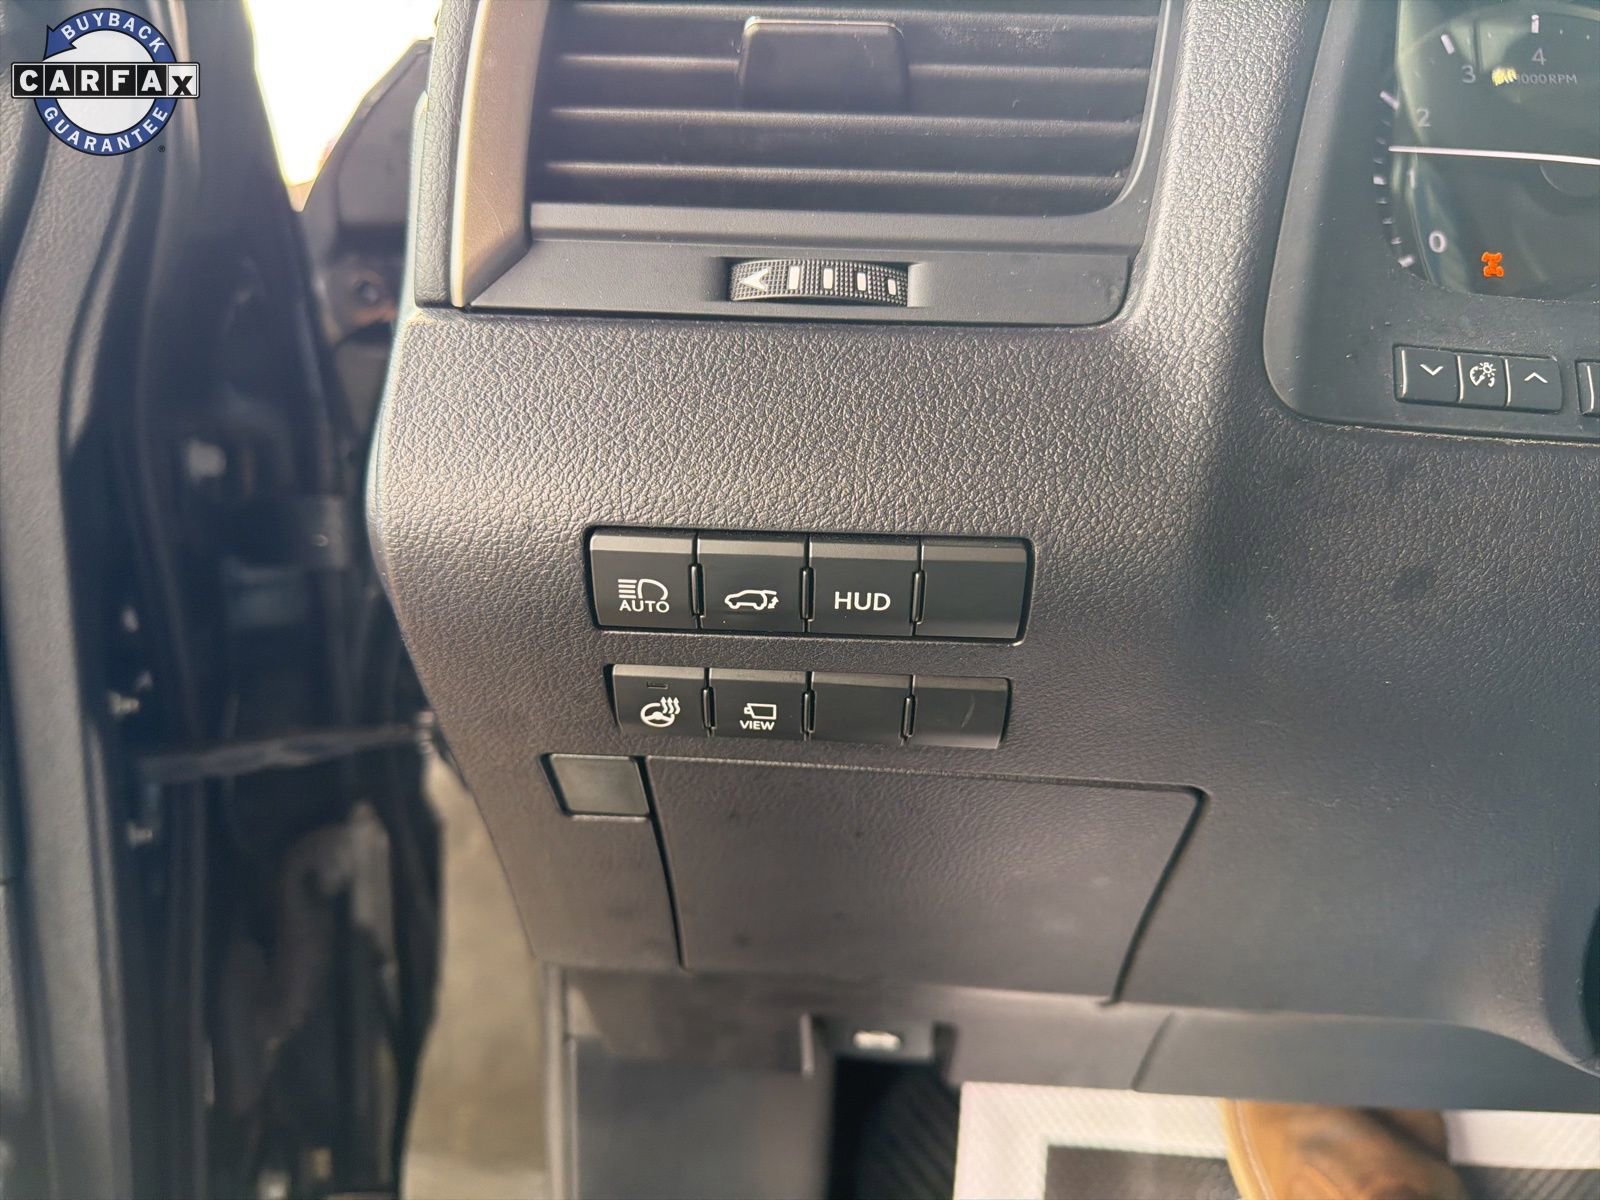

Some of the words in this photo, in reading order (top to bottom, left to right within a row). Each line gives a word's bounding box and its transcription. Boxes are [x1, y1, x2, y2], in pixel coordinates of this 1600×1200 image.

[1532, 48, 1547, 65] 4
[1461, 65, 1476, 84] 3
[1416, 109, 1431, 127] 2
[1429, 231, 1446, 253] 0
[618, 600, 670, 613] AUTO
[834, 591, 891, 611] HUD
[739, 719, 775, 731] VIEW
